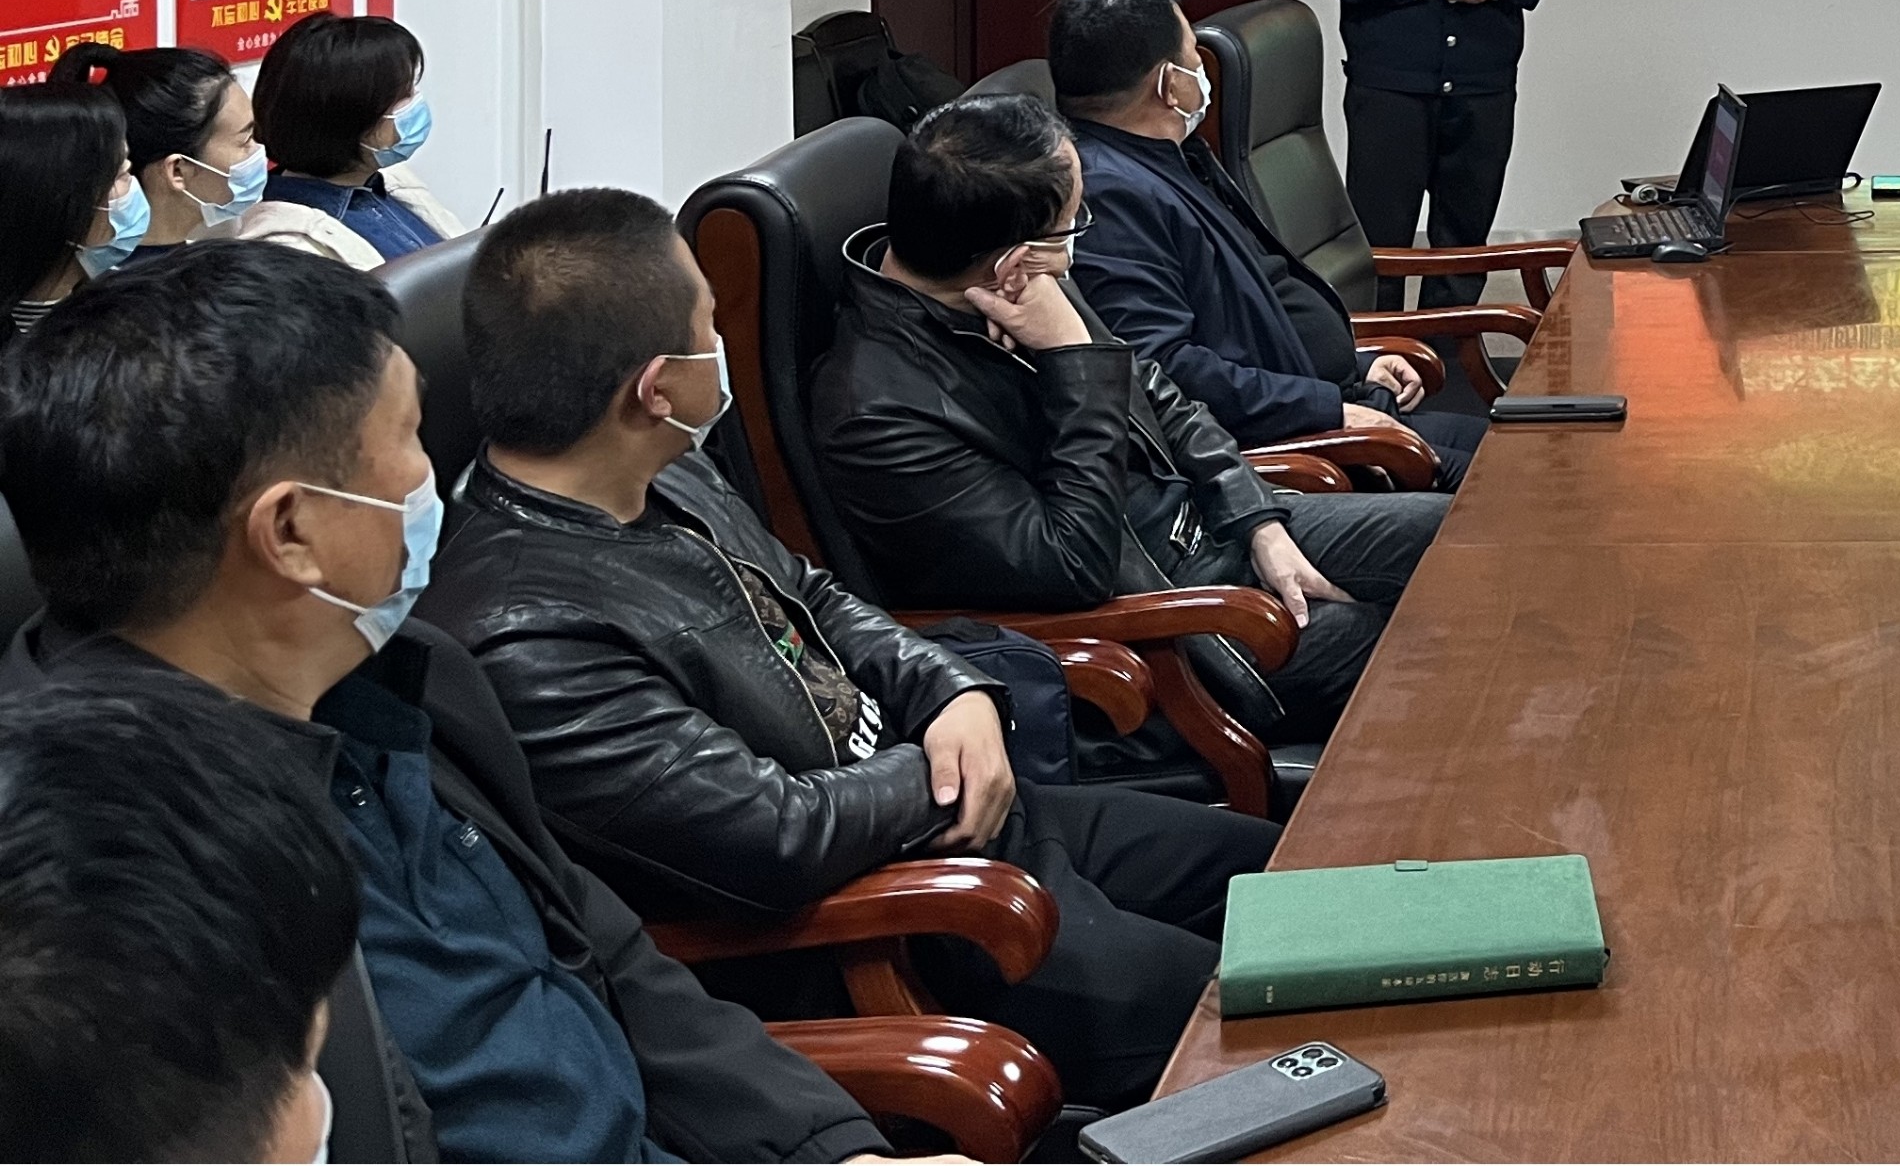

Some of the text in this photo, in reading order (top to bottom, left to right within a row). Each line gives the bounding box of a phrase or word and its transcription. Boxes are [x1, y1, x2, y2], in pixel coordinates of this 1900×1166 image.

[237, 31, 282, 51] 全心全意为
[1484, 959, 1566, 982] 行动日志
